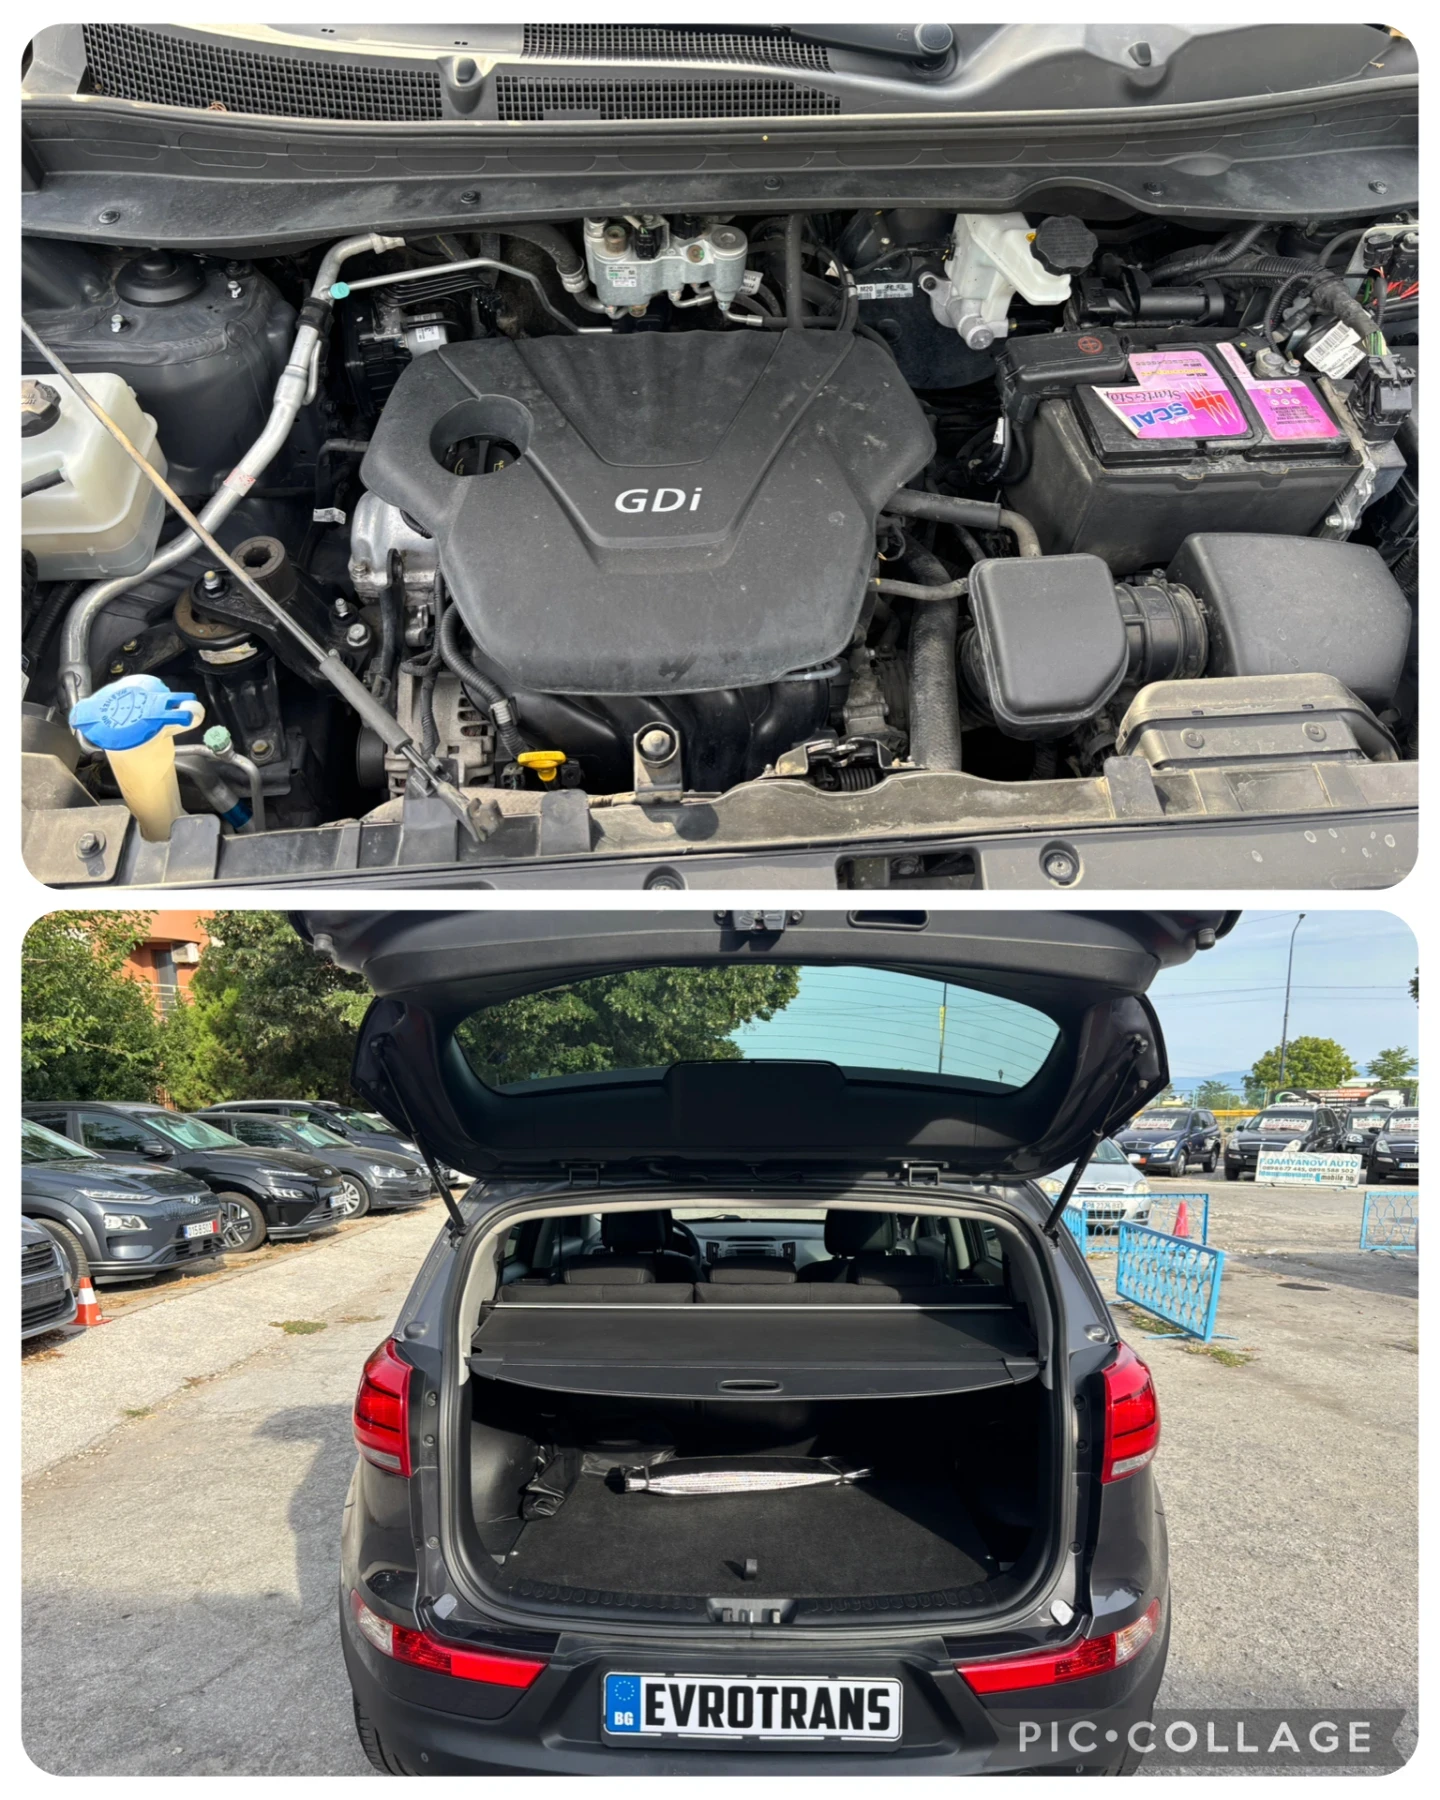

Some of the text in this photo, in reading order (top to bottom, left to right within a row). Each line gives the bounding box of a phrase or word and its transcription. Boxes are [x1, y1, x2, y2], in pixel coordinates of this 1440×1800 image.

[614, 487, 702, 513] GDi
[1329, 1160, 1358, 1168] AUTO
[614, 1683, 891, 1731] BG EVROTRANS
